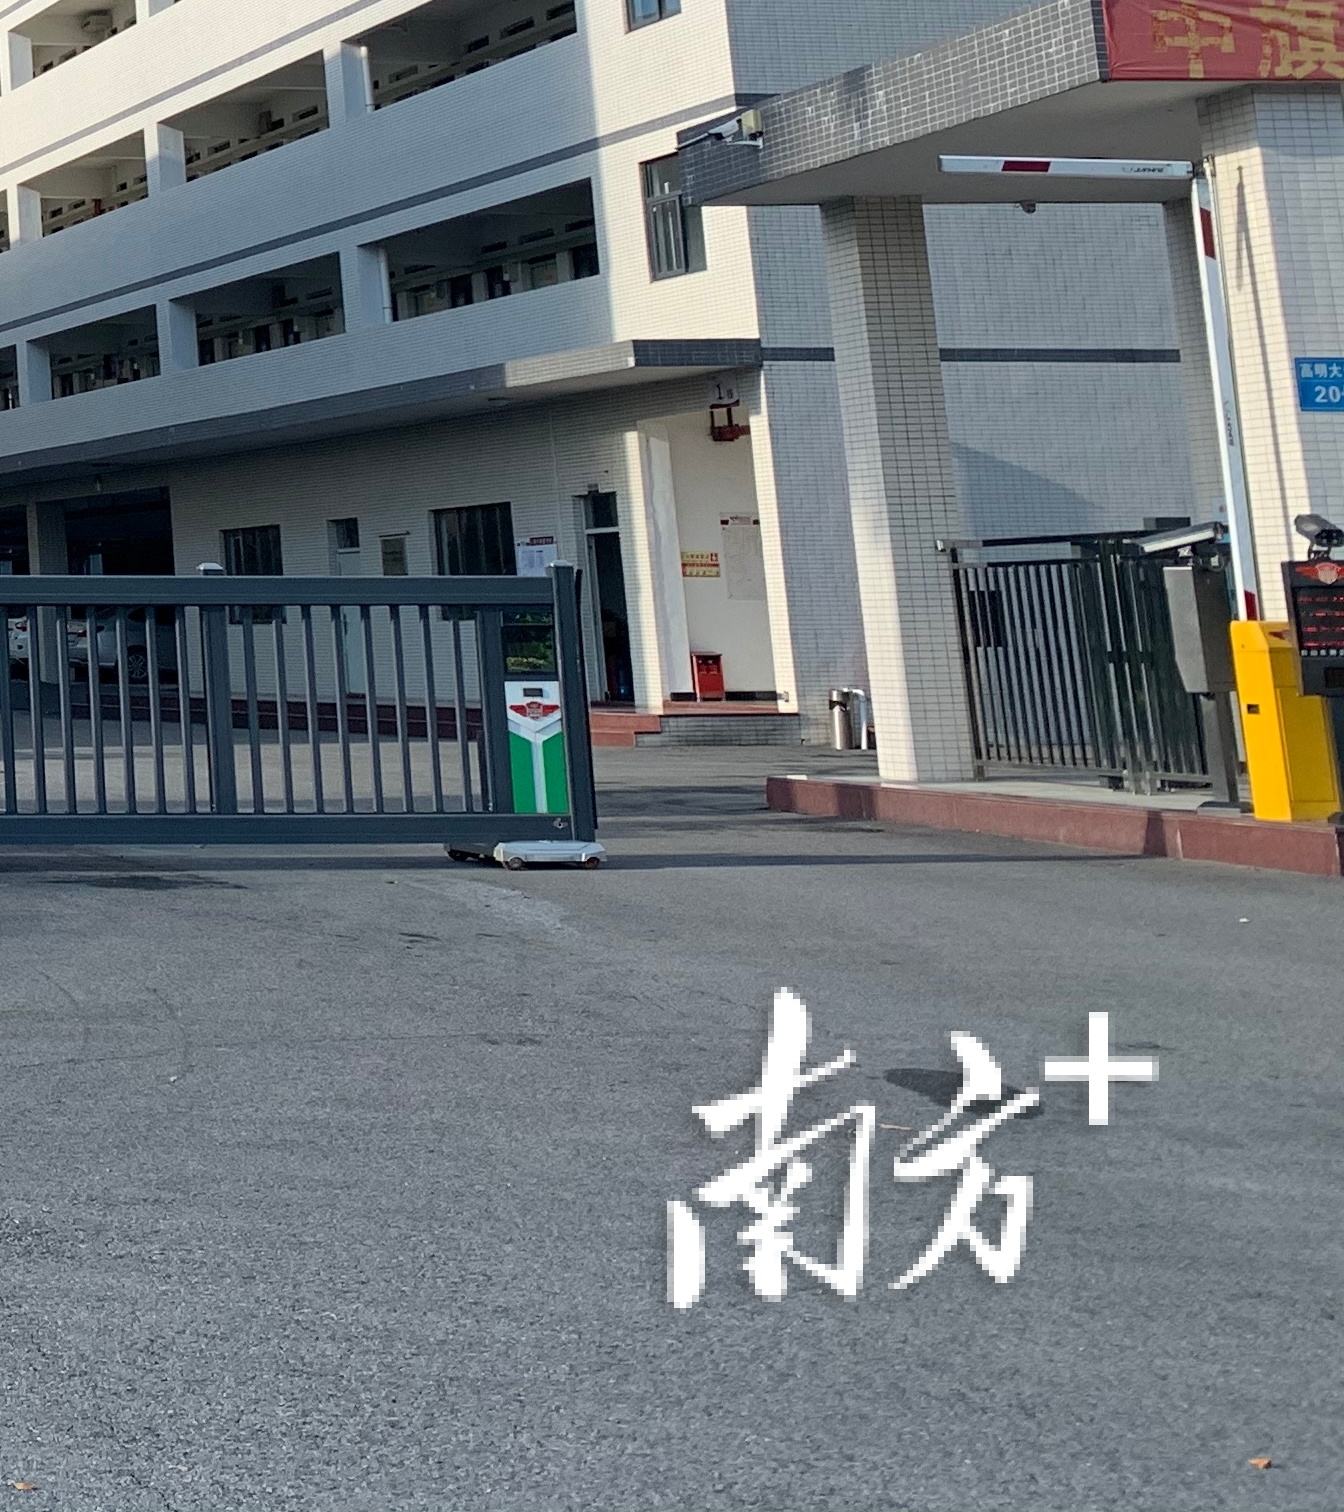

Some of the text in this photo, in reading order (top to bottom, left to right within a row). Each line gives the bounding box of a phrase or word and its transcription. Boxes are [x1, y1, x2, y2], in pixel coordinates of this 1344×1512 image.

[1299, 362, 1344, 378] 高明大
[1314, 385, 1344, 403] 20
